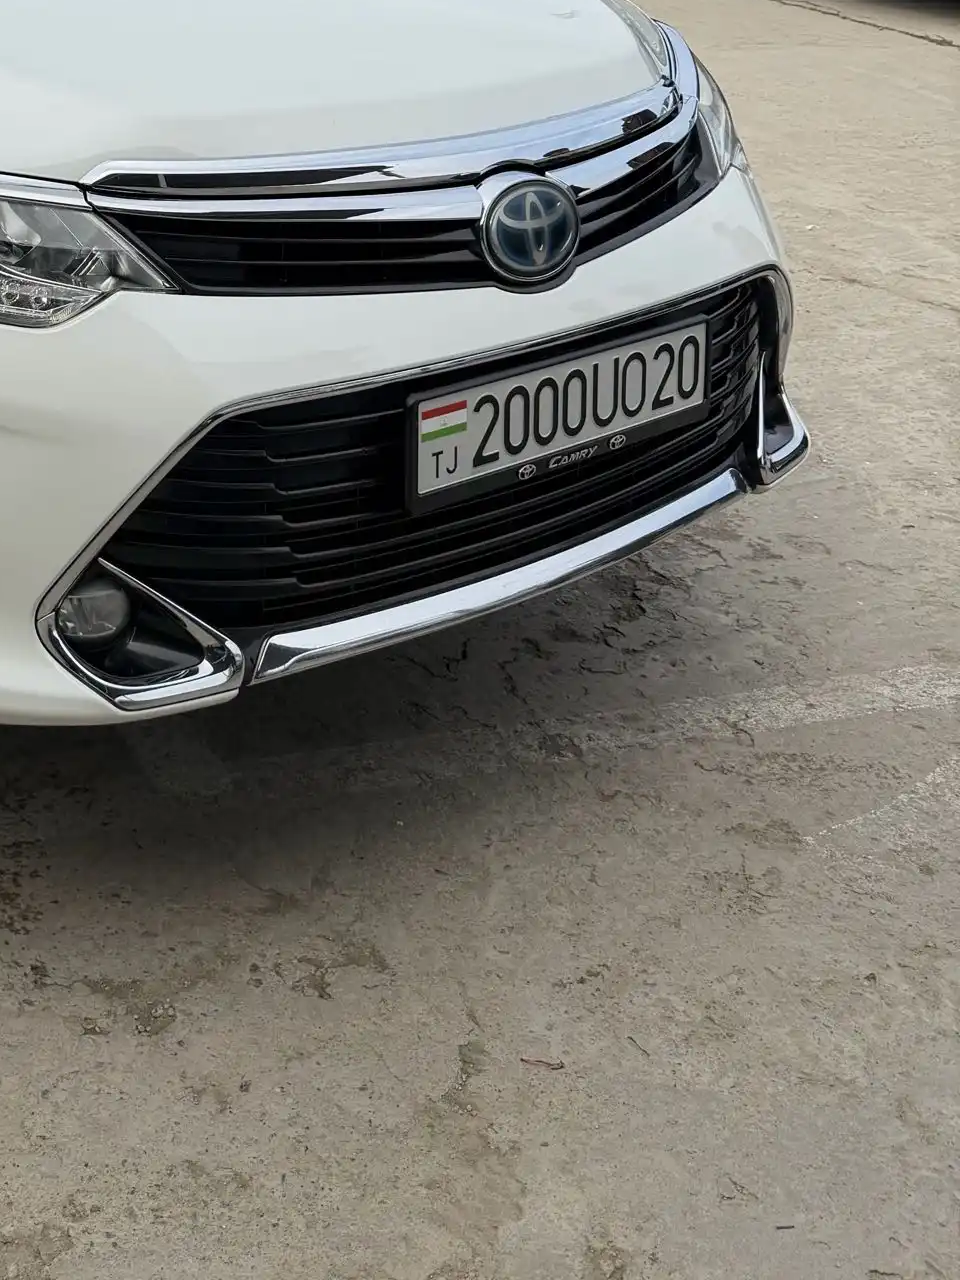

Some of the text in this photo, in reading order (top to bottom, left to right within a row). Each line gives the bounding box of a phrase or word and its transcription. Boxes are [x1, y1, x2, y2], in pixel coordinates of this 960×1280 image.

[472, 334, 700, 468] 2000UO20
[431, 446, 458, 478] TJ
[547, 443, 599, 470] CAMRY
